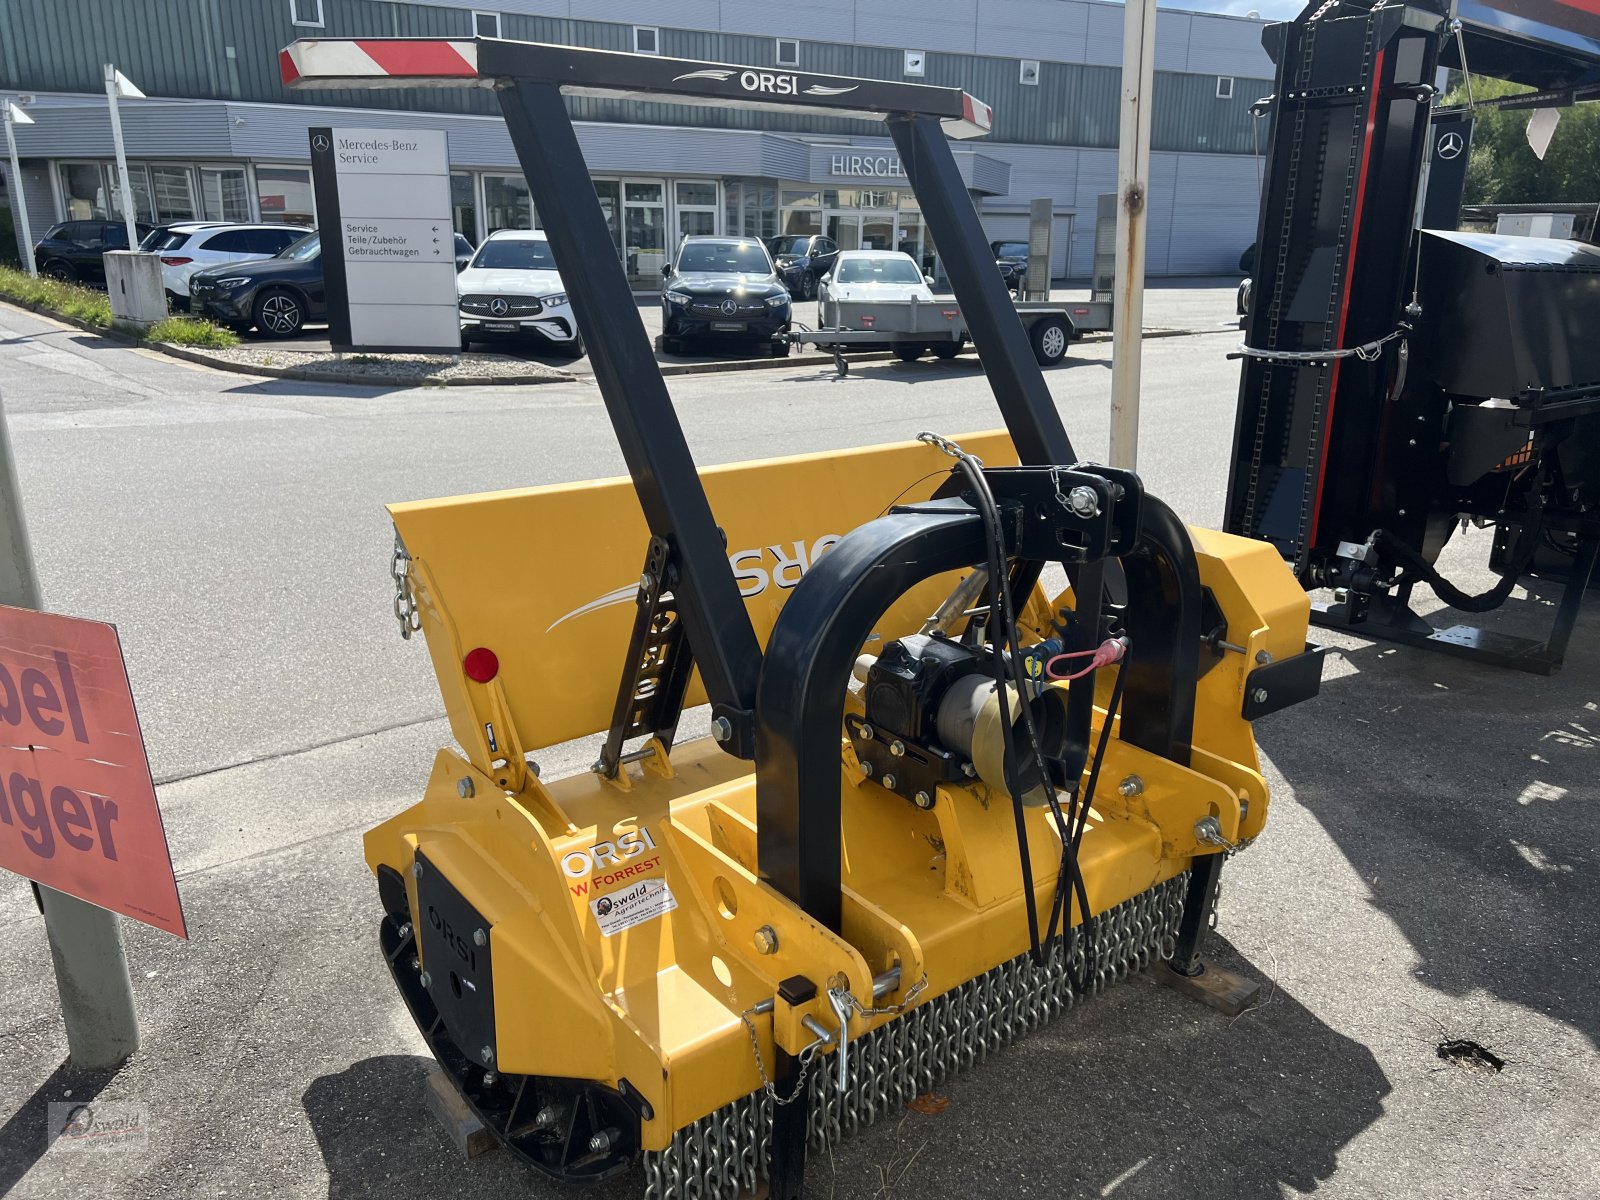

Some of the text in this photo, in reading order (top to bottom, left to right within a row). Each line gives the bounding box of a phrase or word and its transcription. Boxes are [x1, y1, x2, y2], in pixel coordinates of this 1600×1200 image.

[740, 70, 799, 96] ORSI
[339, 139, 418, 151] Mercedes-Benz
[340, 153, 378, 164] Service
[832, 155, 908, 177] HIRSCH
[346, 224, 378, 233] Service
[348, 235, 407, 246] Teile/Zubehör
[348, 247, 420, 257] Gebrauchtwagen
[560, 827, 657, 878] ORSI
[570, 882, 589, 897] W
[614, 886, 668, 917] Agrartechnik
[428, 904, 476, 973] ORSI
